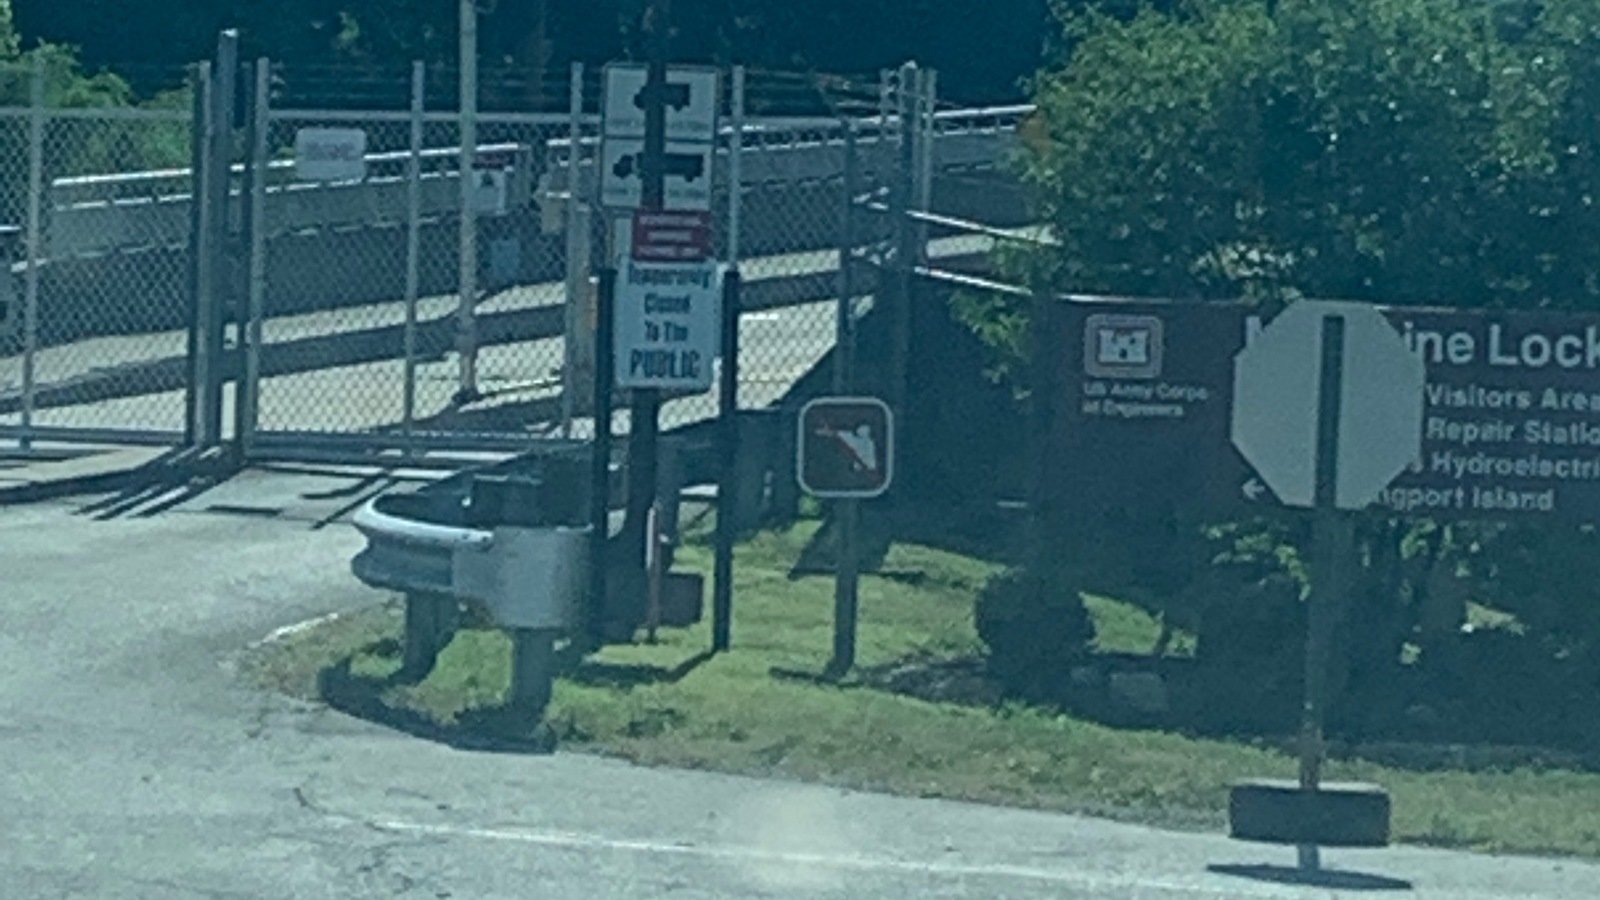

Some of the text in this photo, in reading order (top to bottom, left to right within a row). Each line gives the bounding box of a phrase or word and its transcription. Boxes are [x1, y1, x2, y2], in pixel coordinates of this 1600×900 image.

[631, 348, 701, 379] PUBLIC
[1426, 384, 1532, 409] Visitors
[1427, 416, 1516, 446] Repair
[1472, 485, 1555, 511] Island
